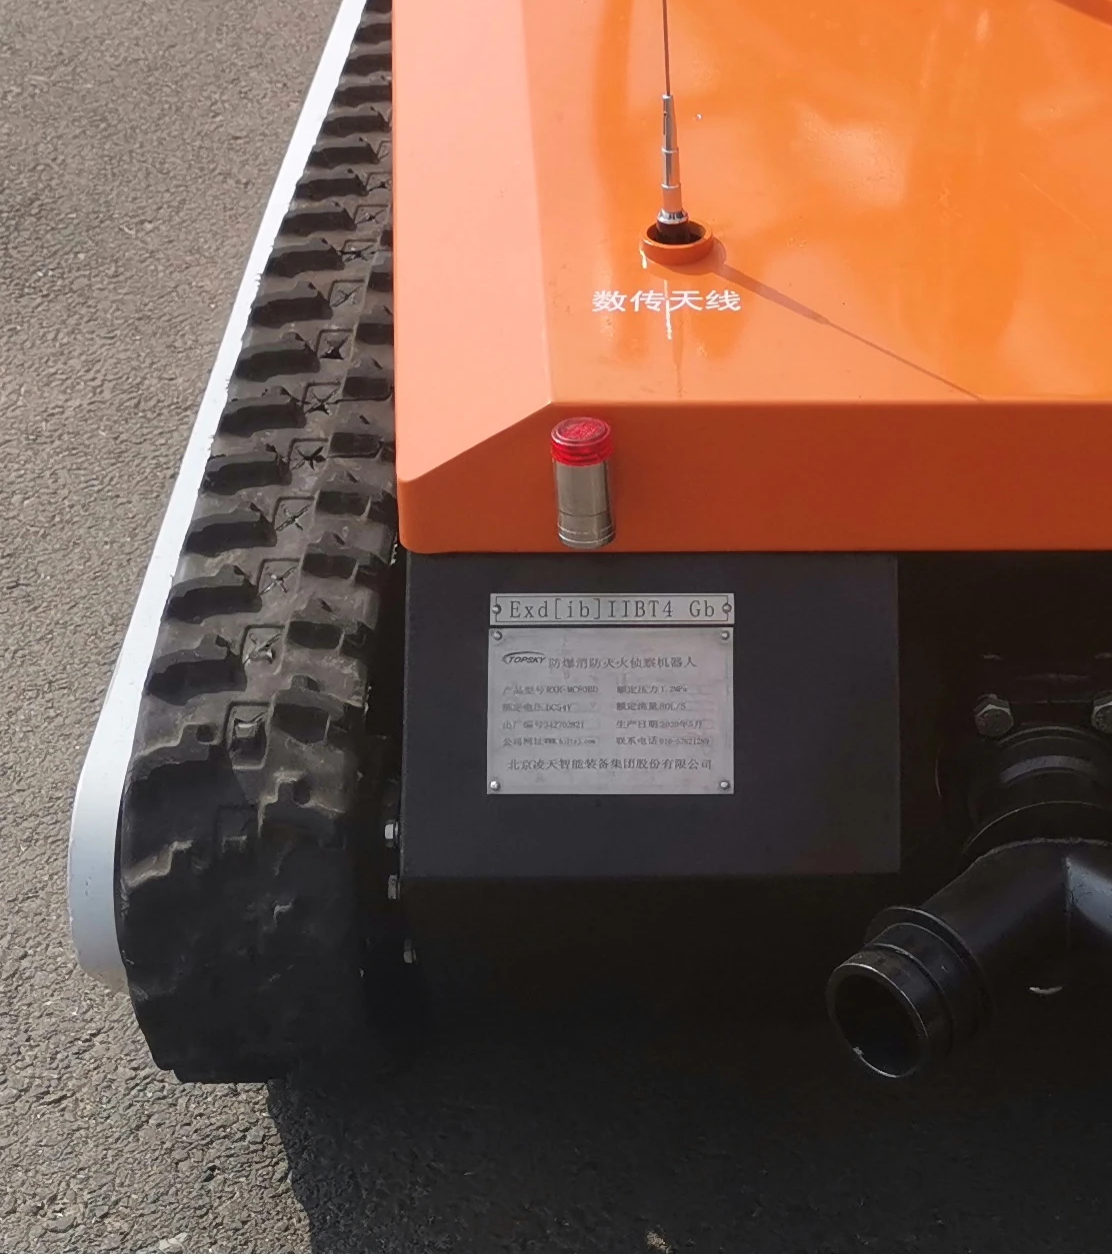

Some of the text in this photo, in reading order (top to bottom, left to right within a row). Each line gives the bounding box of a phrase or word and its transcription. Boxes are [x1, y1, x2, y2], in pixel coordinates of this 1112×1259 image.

[591, 289, 742, 313] 数传天线
[509, 598, 716, 621] Exd[ib]IIBT4 Gb
[507, 654, 546, 665] TOPSKY
[507, 758, 713, 771] 北京凌天智能装备集团股份有限公司
